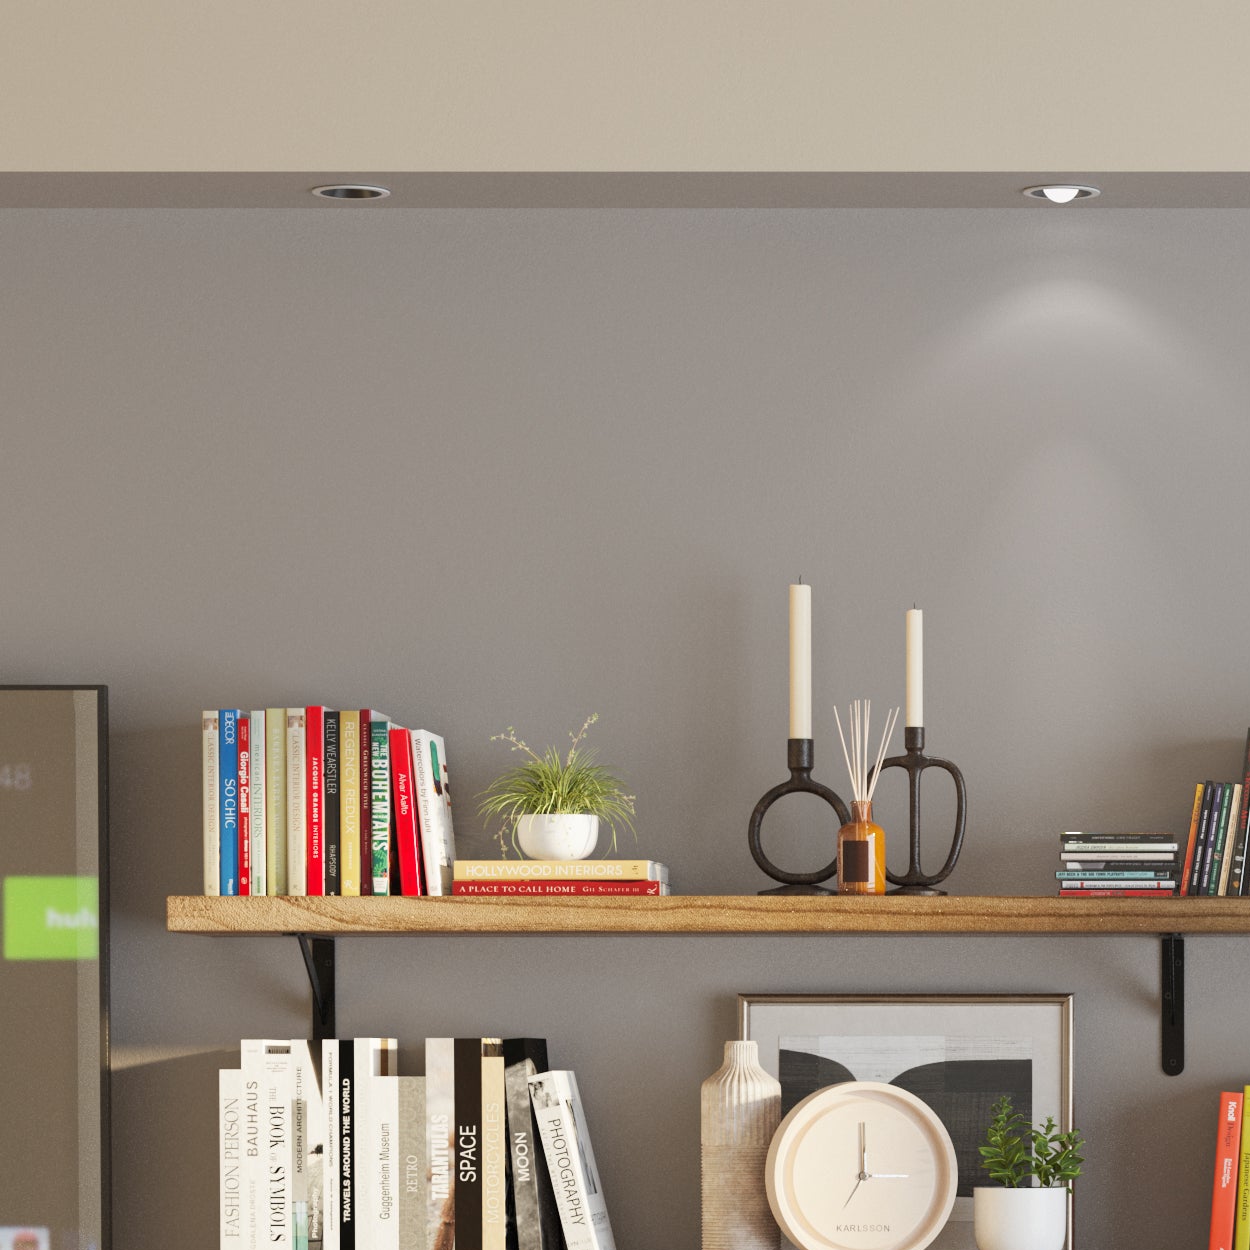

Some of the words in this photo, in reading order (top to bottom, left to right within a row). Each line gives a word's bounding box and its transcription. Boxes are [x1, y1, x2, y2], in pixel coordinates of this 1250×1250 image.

[224, 716, 234, 744] DECOR
[293, 730, 302, 762] CLASSIC
[326, 718, 336, 742] KELLY
[239, 751, 248, 784] Giorgio
[344, 721, 355, 785] REGENCY
[372, 742, 380, 757] NEW
[414, 738, 426, 786] Watercolors
[224, 778, 235, 796] SO
[293, 764, 301, 800] INTERIOR
[326, 744, 336, 794] WEARSTLER
[398, 773, 406, 792] Alvar
[240, 786, 248, 813] Casali
[254, 783, 262, 838] INTERIORS
[345, 789, 355, 834] REDUX
[372, 759, 388, 851] BOHEMIANS
[400, 794, 408, 815] Aalto
[419, 788, 428, 797] by
[224, 798, 235, 829] CHIC
[293, 802, 301, 832] DESIGN
[466, 864, 551, 877] HOLLYWOOD
[555, 864, 623, 876] INTERIORS
[224, 1098, 240, 1161] PERSON
[247, 1081, 258, 1157] BAUHAUS
[270, 1106, 285, 1148] BOOK
[1227, 1101, 1237, 1122] Knoll
[380, 1123, 390, 1161] Museum
[460, 1125, 476, 1182] SPACE
[1225, 1122, 1234, 1147] Design
[406, 1155, 418, 1193] RETRO
[431, 1115, 448, 1200] TARANTULAS
[487, 1103, 499, 1224] MOTORCYCLES
[515, 1132, 529, 1182] MOON
[548, 1118, 586, 1225] PHOTOGRAPHY
[225, 1165, 240, 1237] FASHION
[270, 1166, 285, 1242] SYMBOLS
[380, 1163, 393, 1220] Guggenheim
[1242, 1188, 1250, 1221] Gardens
[836, 1224, 890, 1232] KARLSSON
